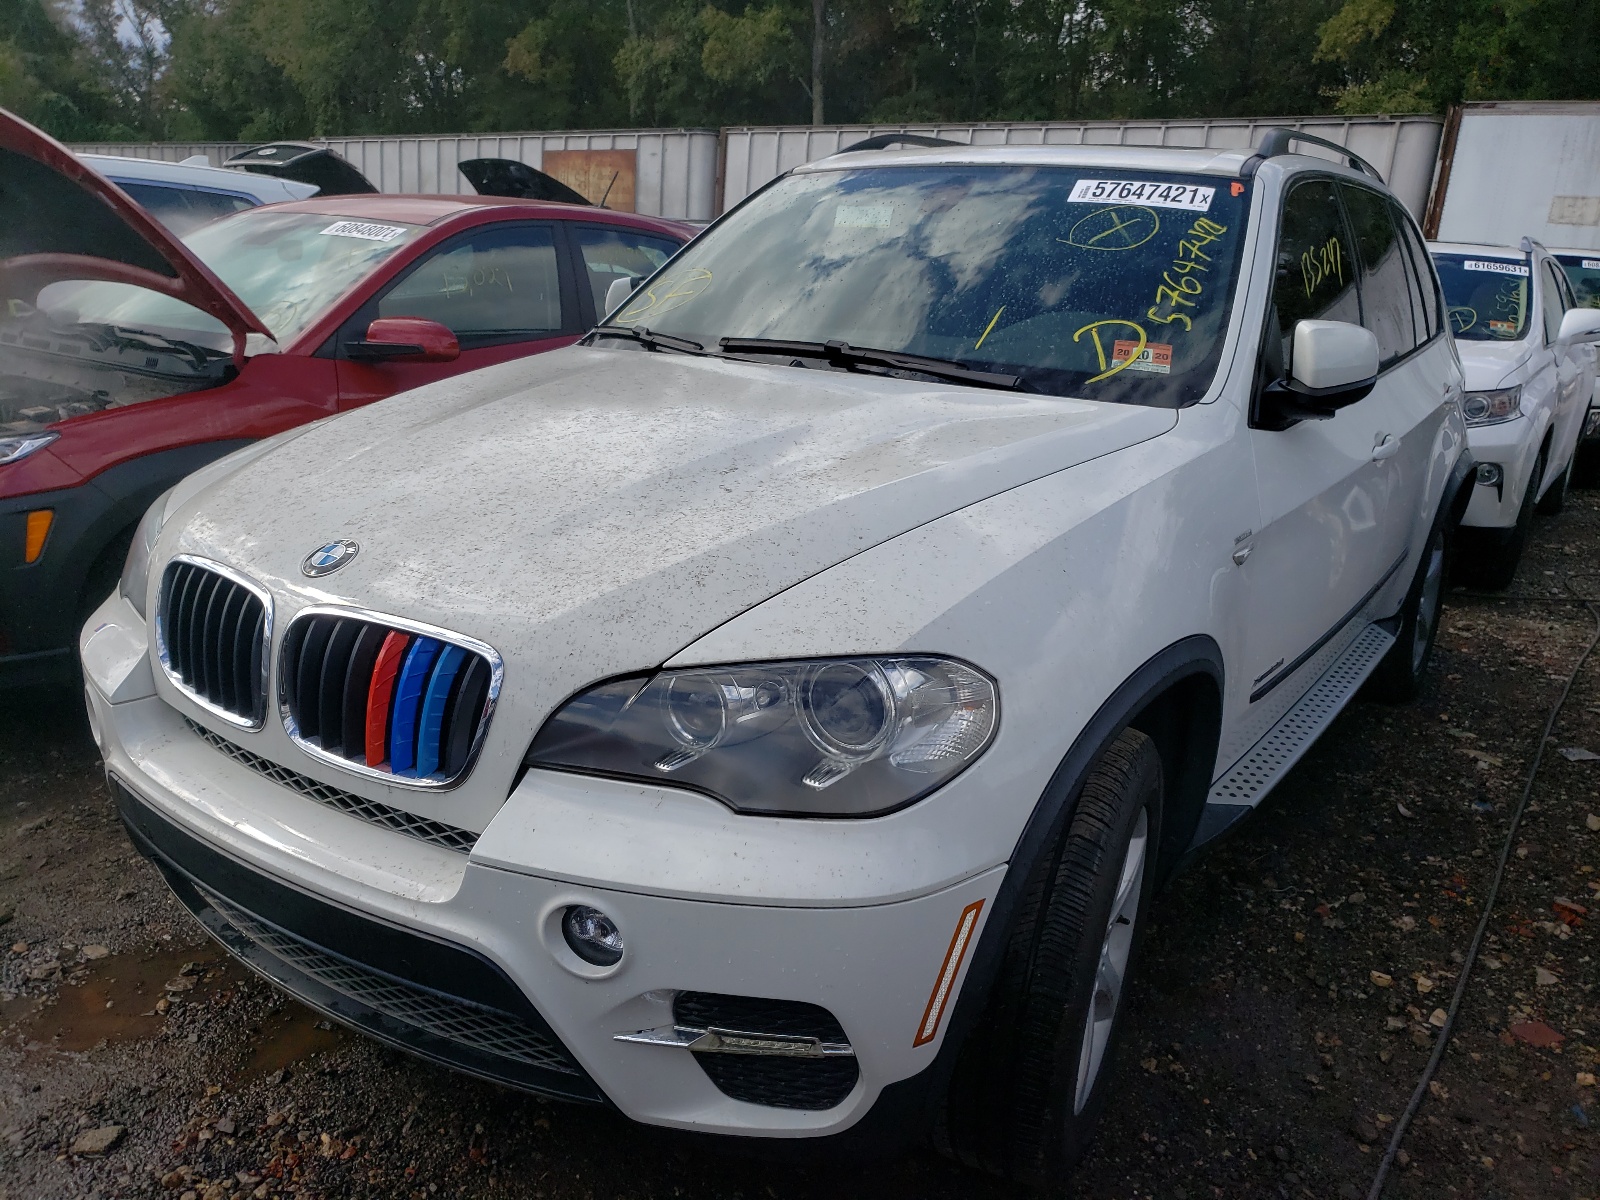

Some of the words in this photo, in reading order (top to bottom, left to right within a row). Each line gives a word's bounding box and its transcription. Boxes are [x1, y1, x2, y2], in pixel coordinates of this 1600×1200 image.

[1091, 181, 1199, 205] 57647421
[1474, 262, 1522, 274] 61659631
[1073, 319, 1147, 384] D
